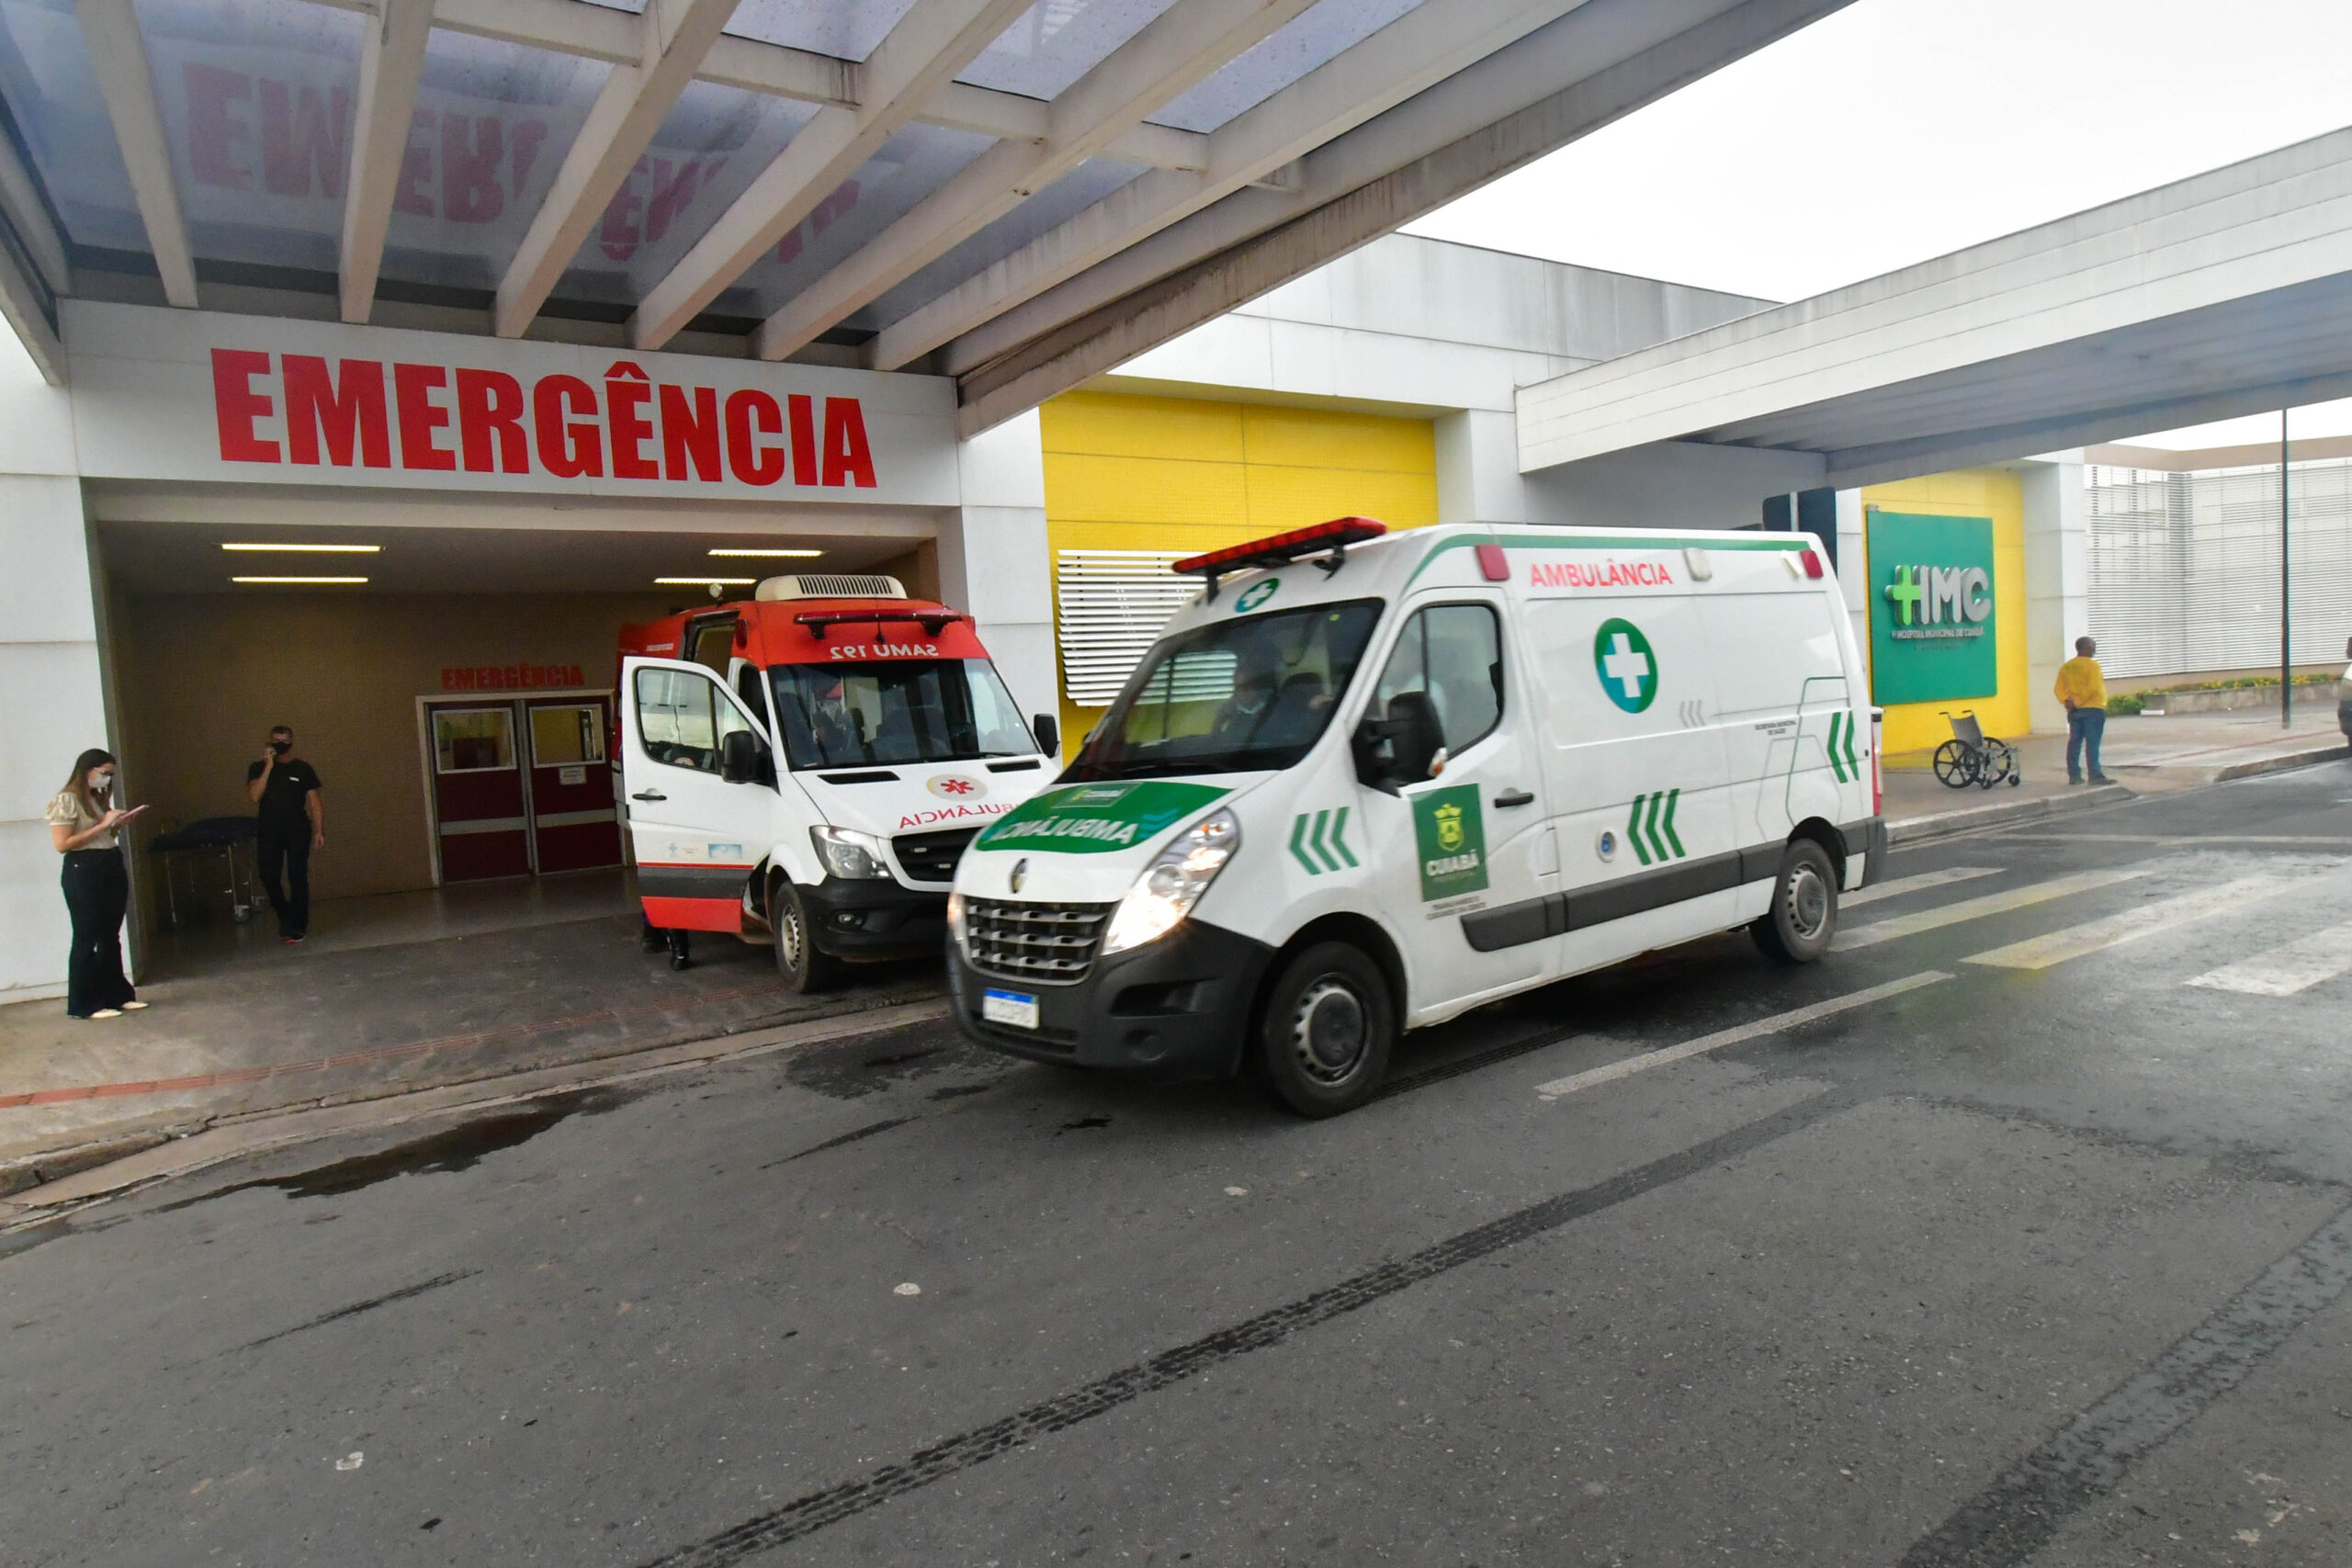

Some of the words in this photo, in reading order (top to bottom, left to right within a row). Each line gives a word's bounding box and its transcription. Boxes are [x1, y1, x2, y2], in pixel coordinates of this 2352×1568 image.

[211, 348, 877, 488] EMERGÊNCIA
[1531, 558, 1673, 587] AMBULÂNCIA
[442, 662, 584, 689] EMERGÊNCIA
[1426, 849, 1479, 876] CUIABÁ
